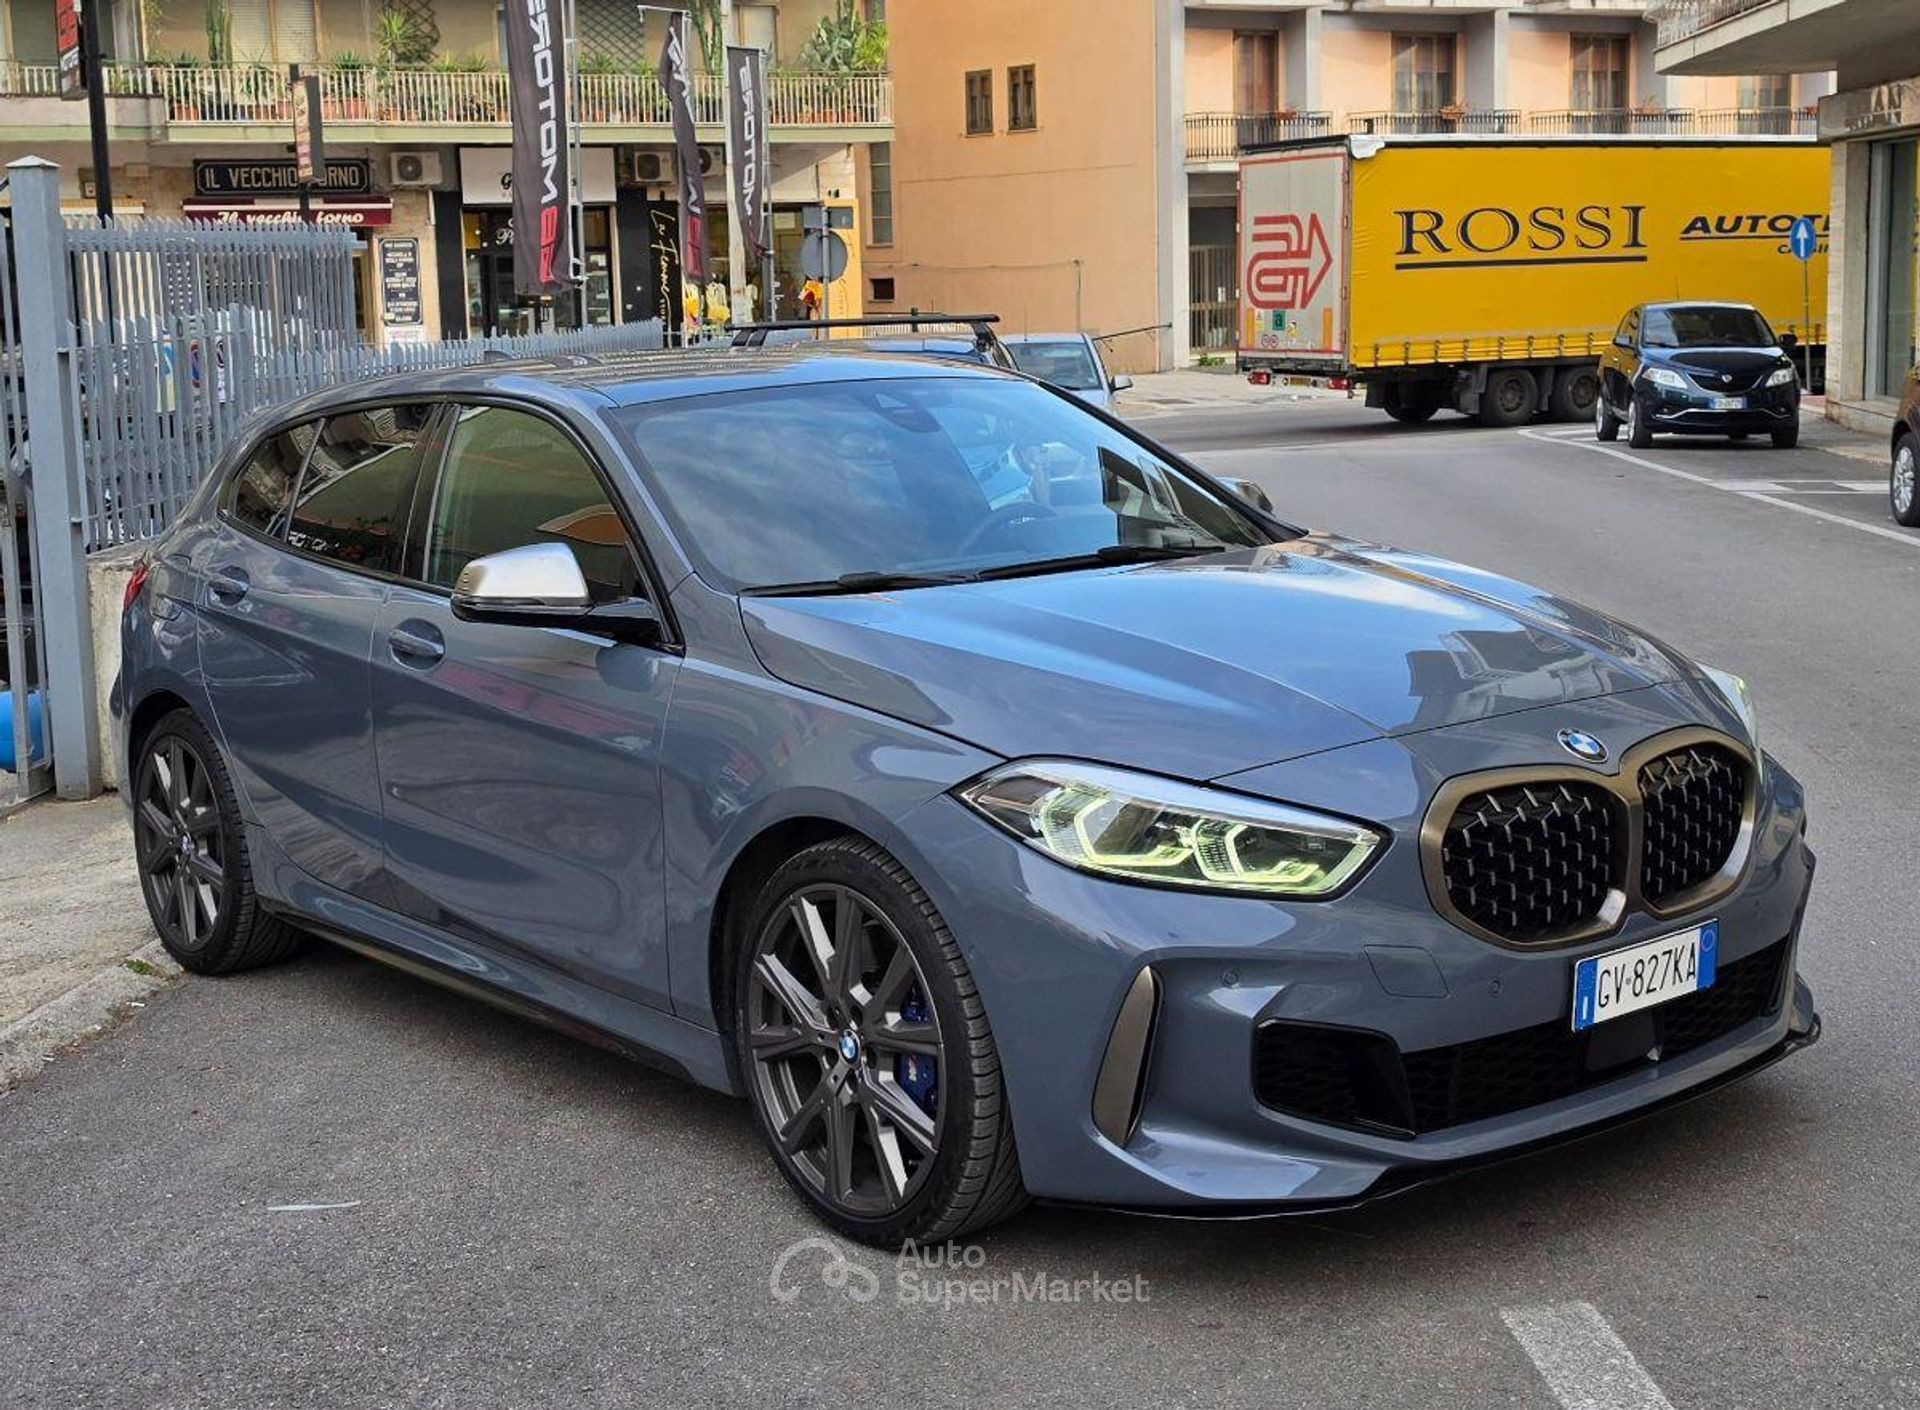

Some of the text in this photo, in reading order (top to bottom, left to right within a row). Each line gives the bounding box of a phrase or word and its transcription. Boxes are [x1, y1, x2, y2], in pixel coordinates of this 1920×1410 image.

[205, 166, 359, 188] IL VECCHIO ORNO
[246, 210, 302, 224] vecchi
[315, 210, 365, 224] forno
[1681, 214, 1829, 234] AUTOT
[1394, 205, 1648, 256] ROSSI
